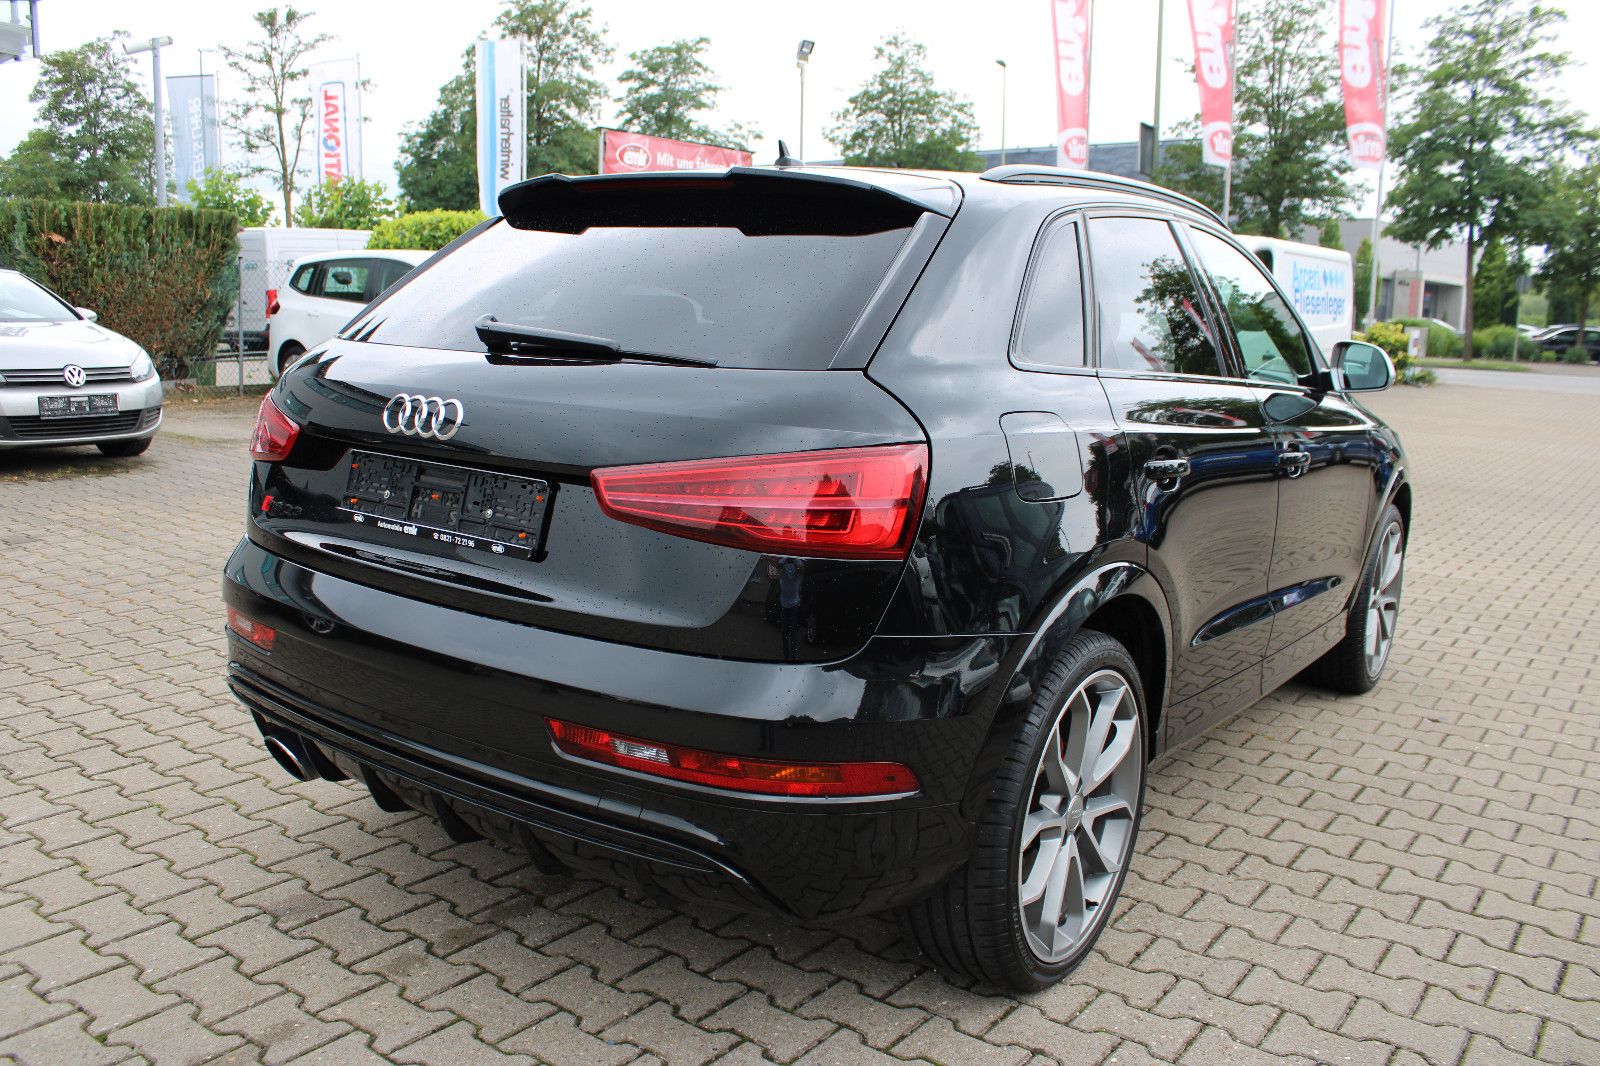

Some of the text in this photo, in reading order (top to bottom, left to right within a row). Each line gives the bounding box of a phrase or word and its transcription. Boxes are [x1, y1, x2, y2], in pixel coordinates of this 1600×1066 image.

[656, 152, 675, 168] Mit
[676, 158, 694, 169] uns
[1294, 287, 1345, 321] Fliesenleger
[377, 520, 418, 536] Automobile emir
